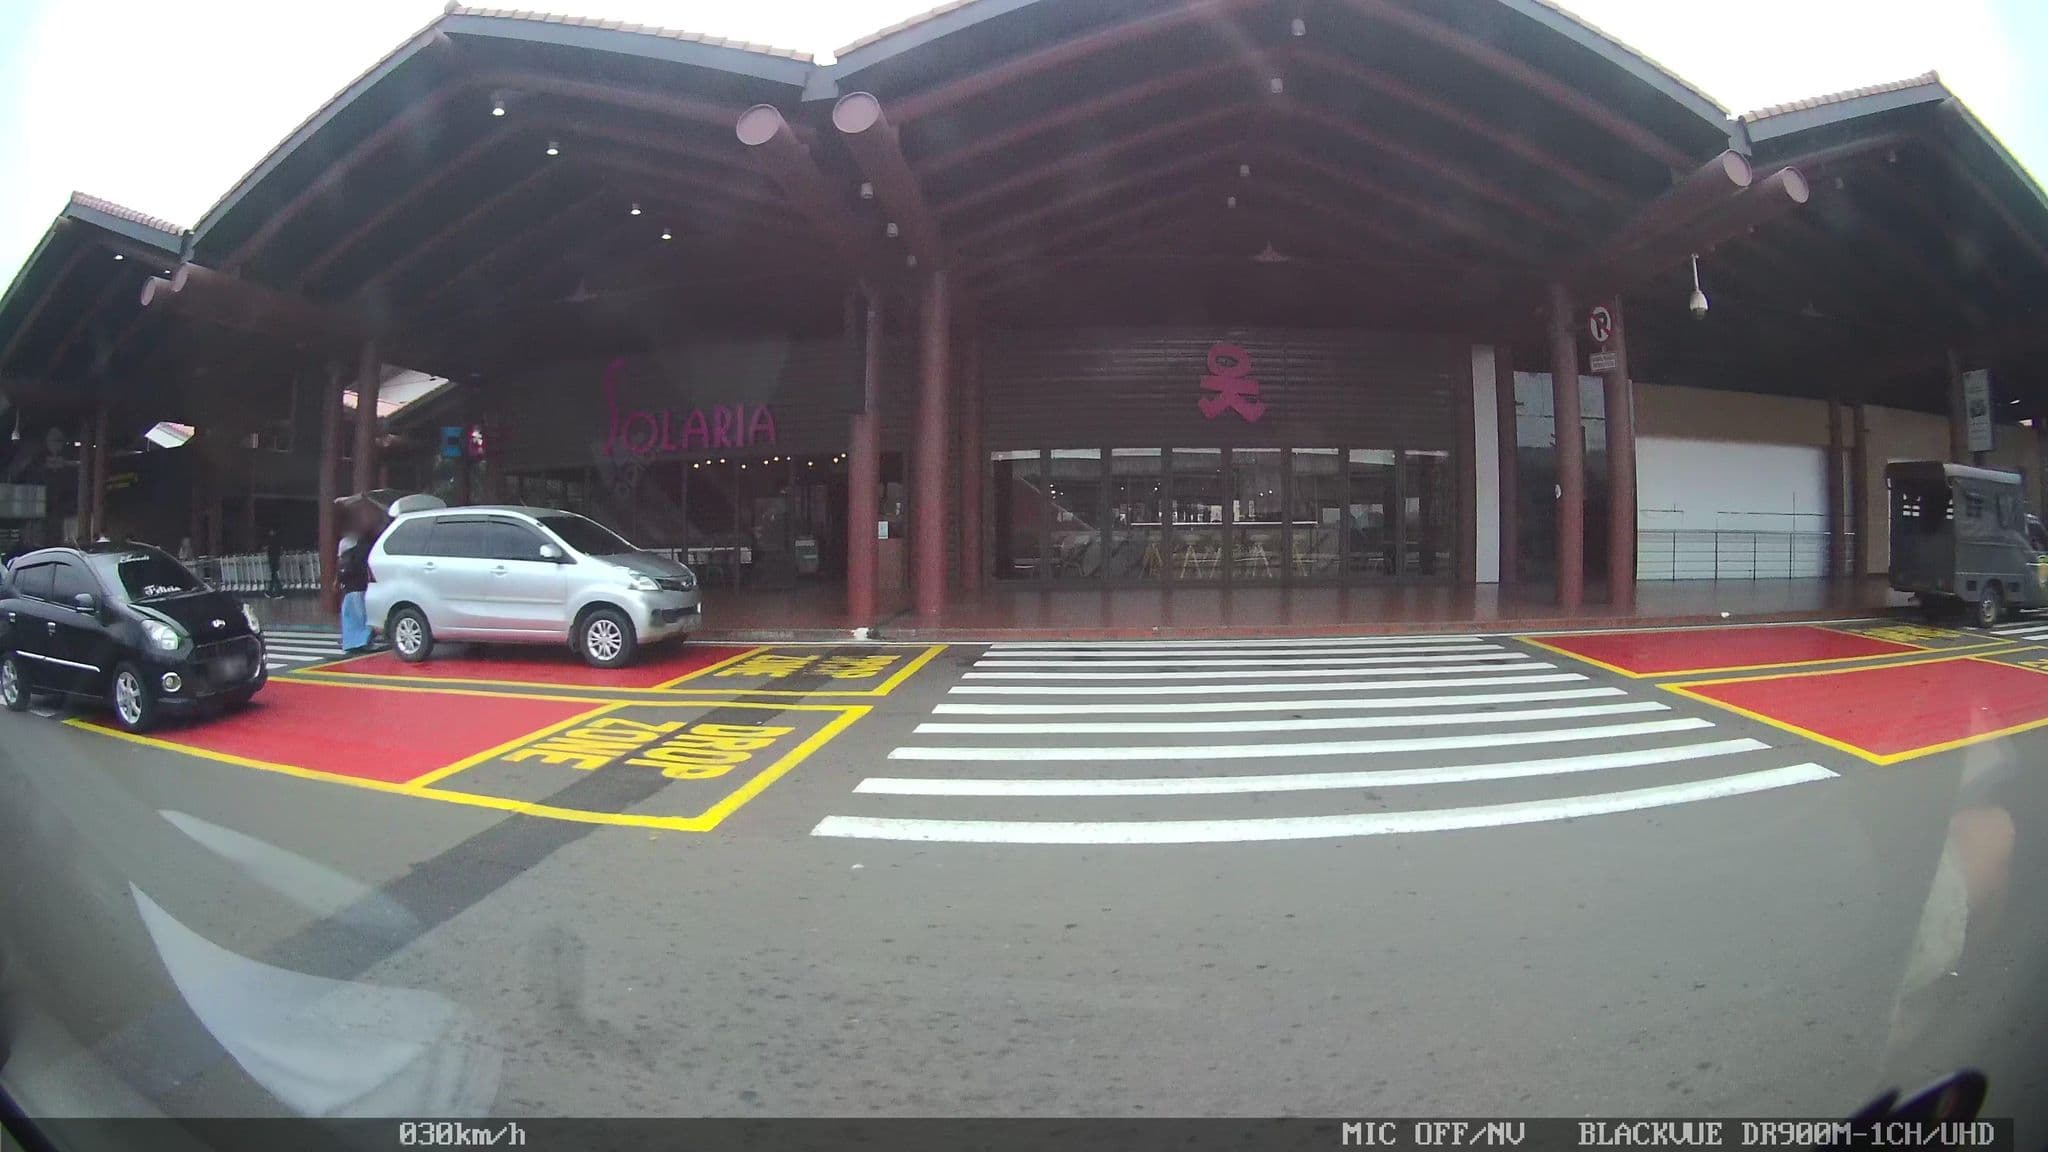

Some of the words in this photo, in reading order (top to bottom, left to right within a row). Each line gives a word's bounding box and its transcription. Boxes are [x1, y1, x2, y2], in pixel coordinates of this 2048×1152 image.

[603, 357, 776, 456] SOLARIA
[503, 717, 688, 771] ZONE
[625, 723, 796, 780] DROP
